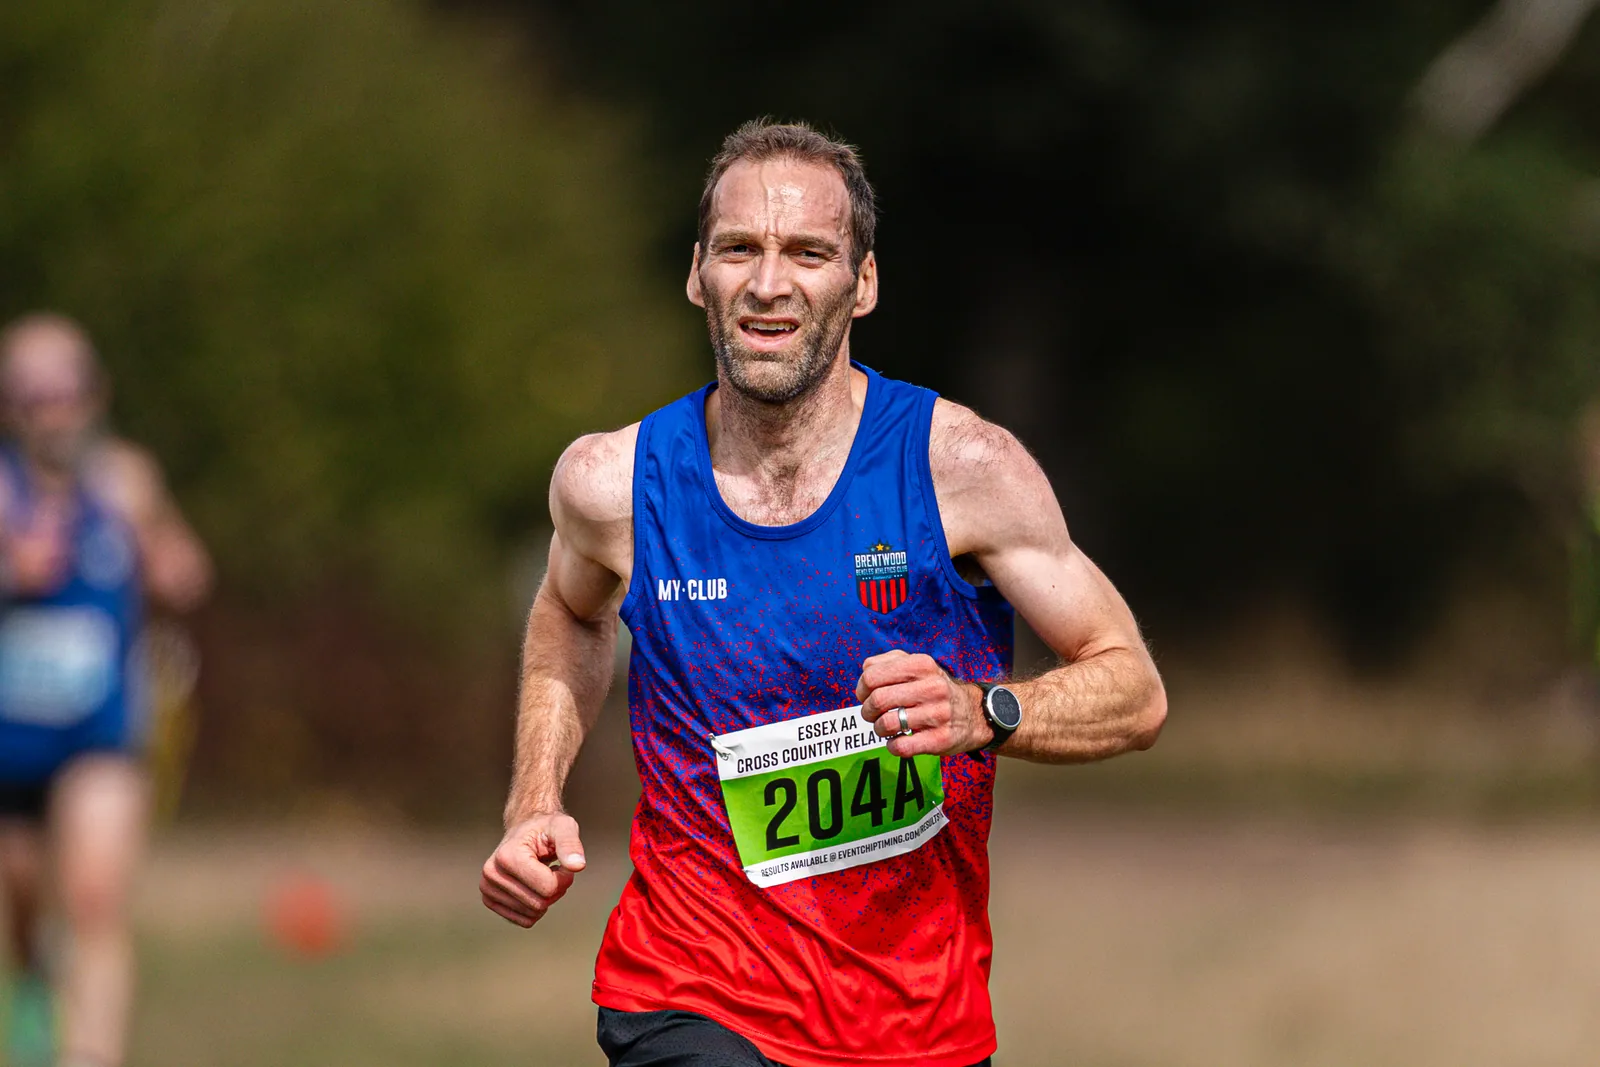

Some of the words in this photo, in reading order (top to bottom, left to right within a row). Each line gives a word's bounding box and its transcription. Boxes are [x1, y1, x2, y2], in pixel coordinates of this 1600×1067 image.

[854, 551, 907, 569] BRENTWOOD
[875, 566, 896, 575] ATHLETICS
[798, 718, 837, 741] ESSEX
[841, 715, 858, 732] AA
[737, 751, 779, 774] CROSS
[782, 738, 841, 764] COUNTRY
[844, 730, 891, 751] RELA
[763, 756, 925, 852] 204A
[760, 861, 790, 877] RESULTS
[790, 853, 829, 871] AVAILABLE
[829, 851, 837, 863] @
